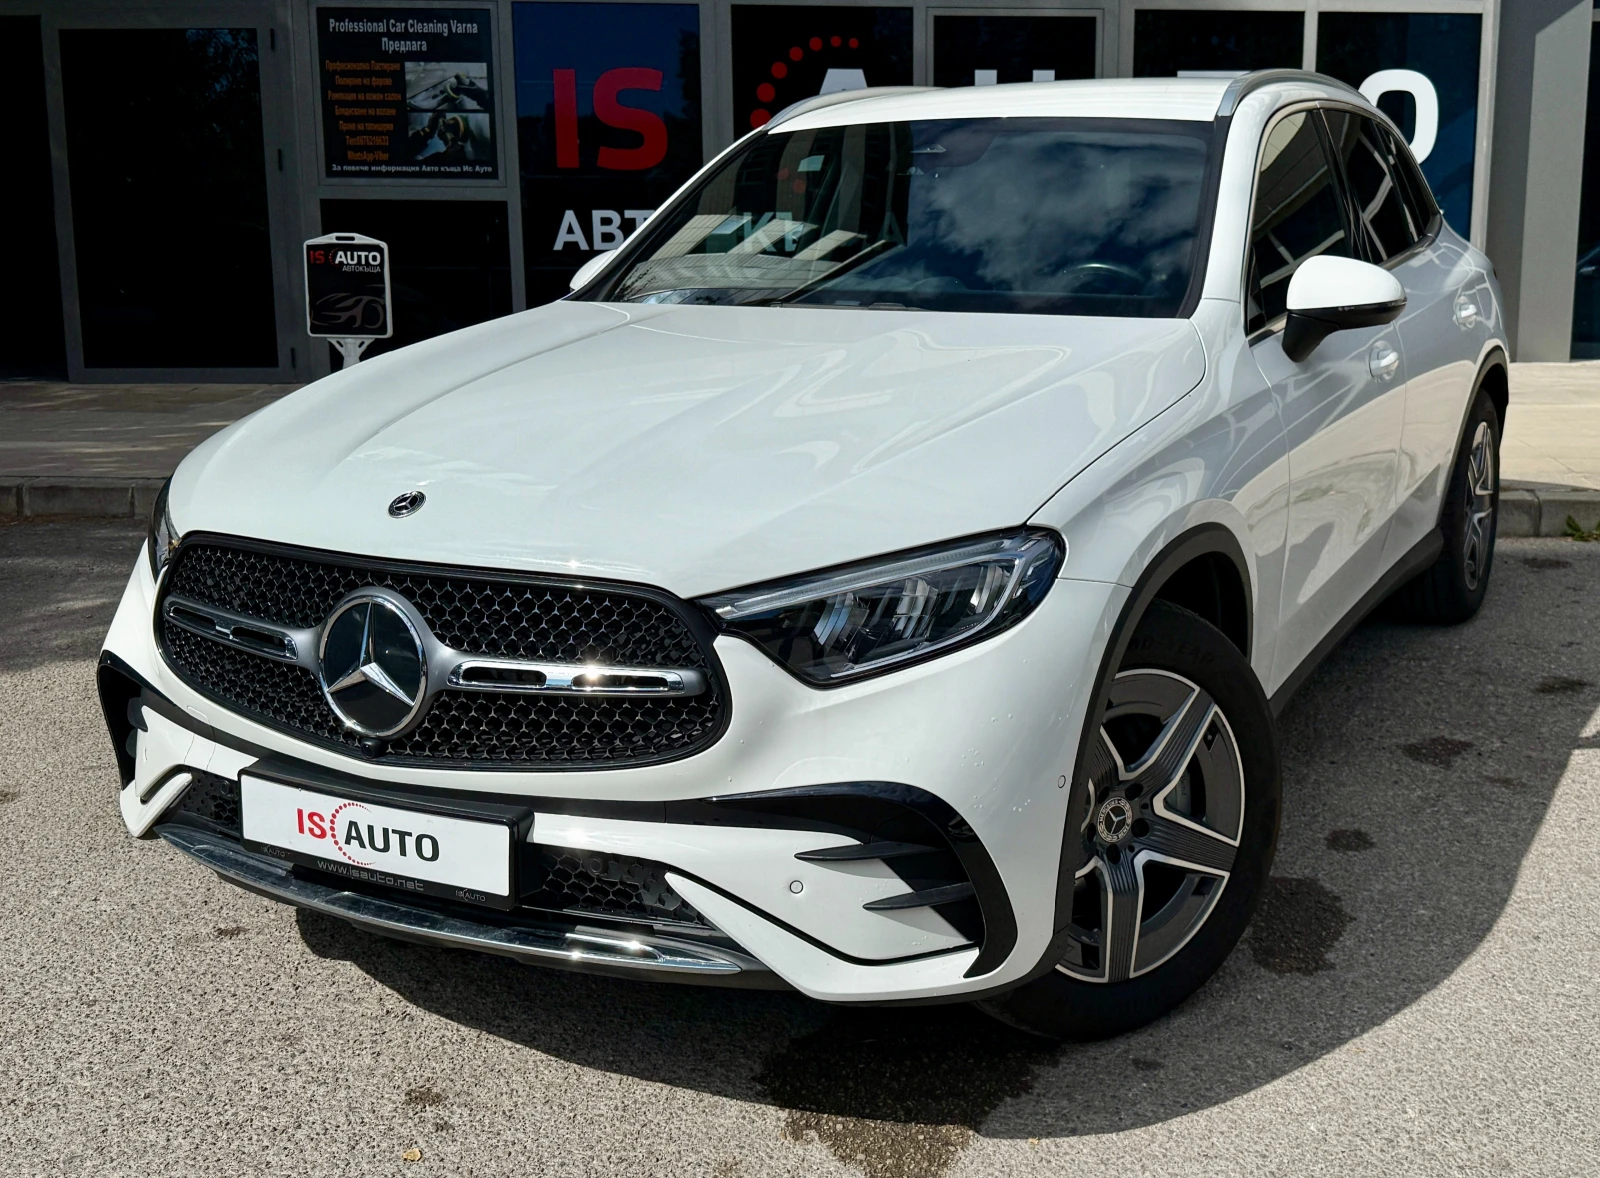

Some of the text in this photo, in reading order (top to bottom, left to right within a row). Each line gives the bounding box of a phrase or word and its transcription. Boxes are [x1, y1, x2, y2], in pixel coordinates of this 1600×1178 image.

[329, 18, 478, 37] Professional Car Cleaning Varna
[381, 37, 428, 54] Предлага
[552, 67, 669, 170] IS
[332, 164, 341, 172] За
[371, 164, 420, 174] информация
[421, 165, 439, 173] Авто
[440, 166, 461, 174] къща
[463, 165, 473, 173] Ис
[474, 165, 493, 174] Ауто
[309, 250, 382, 266] IS AUTO
[342, 265, 382, 273] АВТОКЪЩА
[296, 807, 440, 863] IS AUTO
[317, 860, 425, 891] www.isauto.net
[465, 892, 486, 902] AUTO
